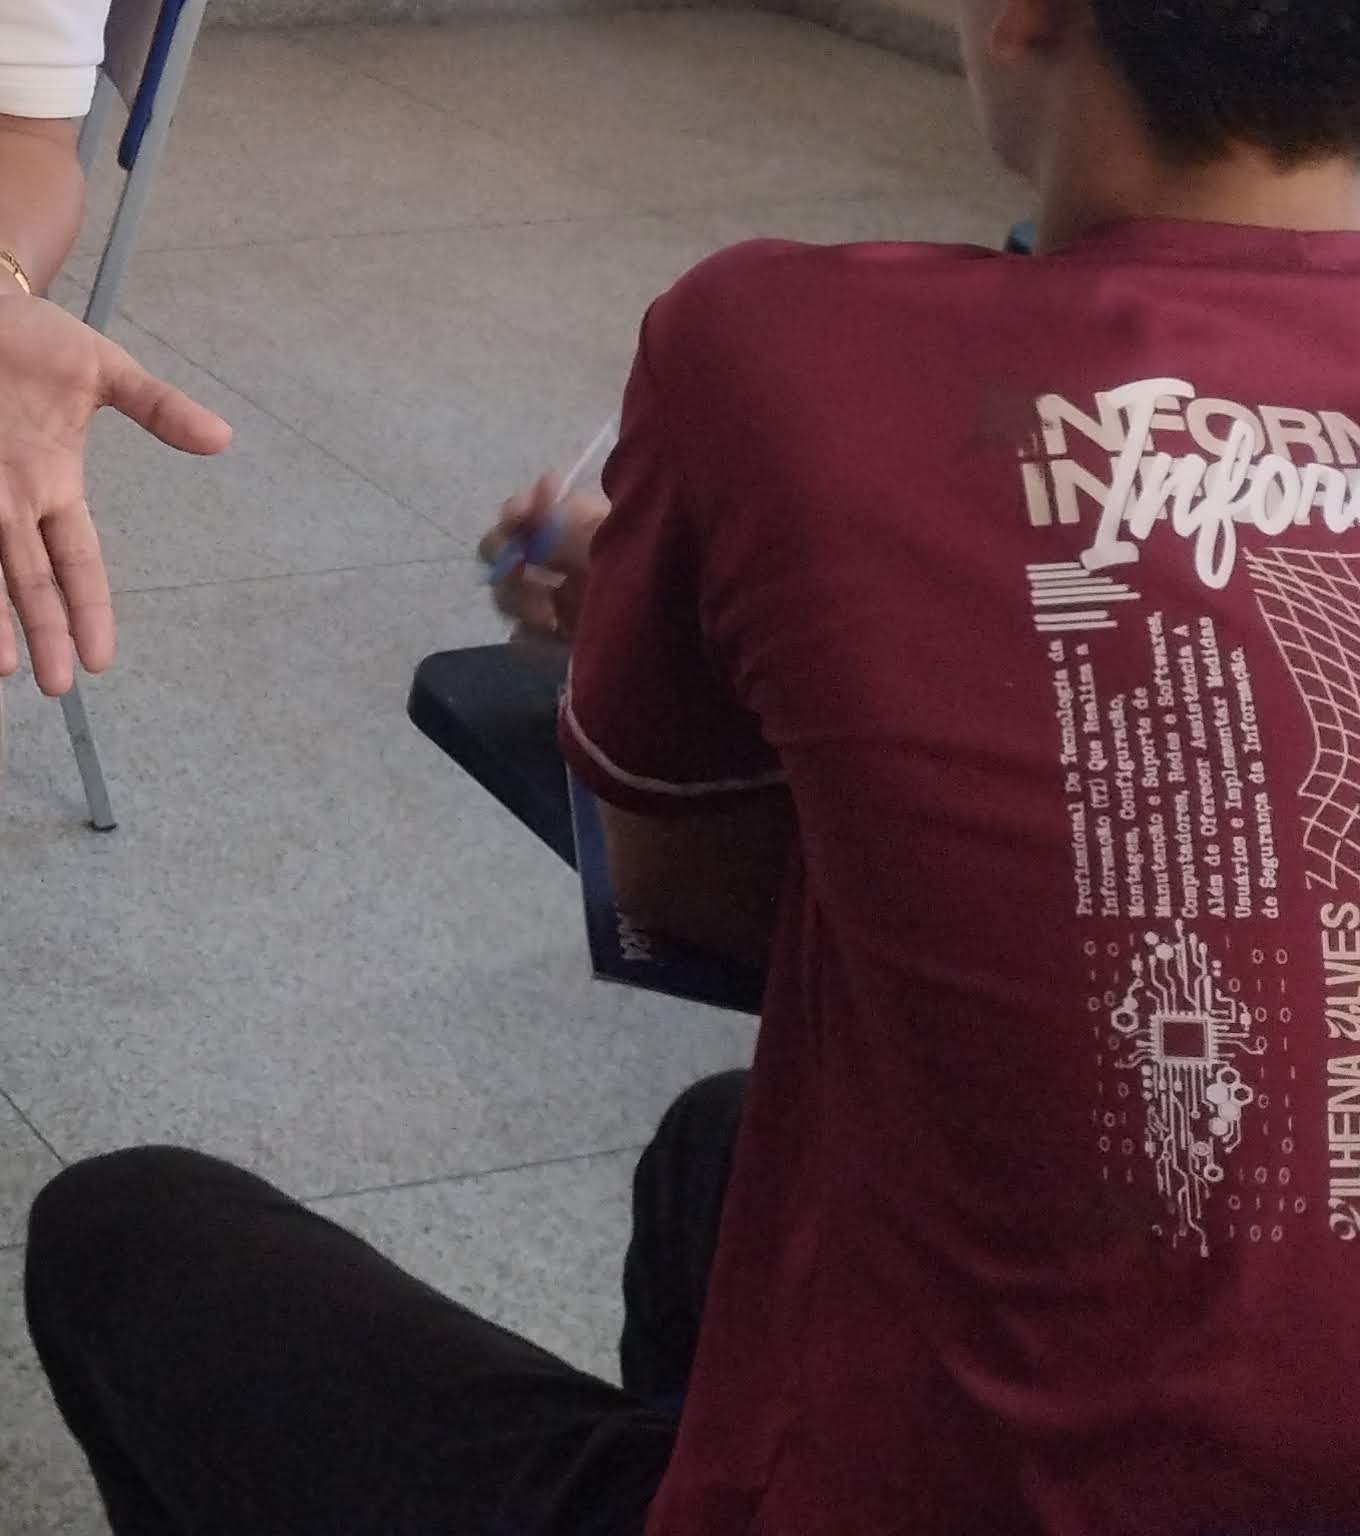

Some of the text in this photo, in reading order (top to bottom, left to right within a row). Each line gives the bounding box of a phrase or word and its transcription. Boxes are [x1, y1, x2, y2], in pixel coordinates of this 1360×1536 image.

[1199, 616, 1225, 688] Medidas
[1053, 668, 1078, 765] Tecnologia
[1132, 687, 1149, 710] de
[1089, 740, 1108, 770] Que
[1135, 716, 1162, 788] Suporte
[1213, 695, 1244, 810] Implementar
[1248, 760, 1266, 784] da
[1067, 800, 1093, 916] Profissional
[1096, 814, 1120, 916] Informação
[1148, 813, 1172, 918] Manutenção
[1203, 843, 1221, 866] de
[1255, 791, 1280, 889] Segurança
[1261, 895, 1280, 920] de
